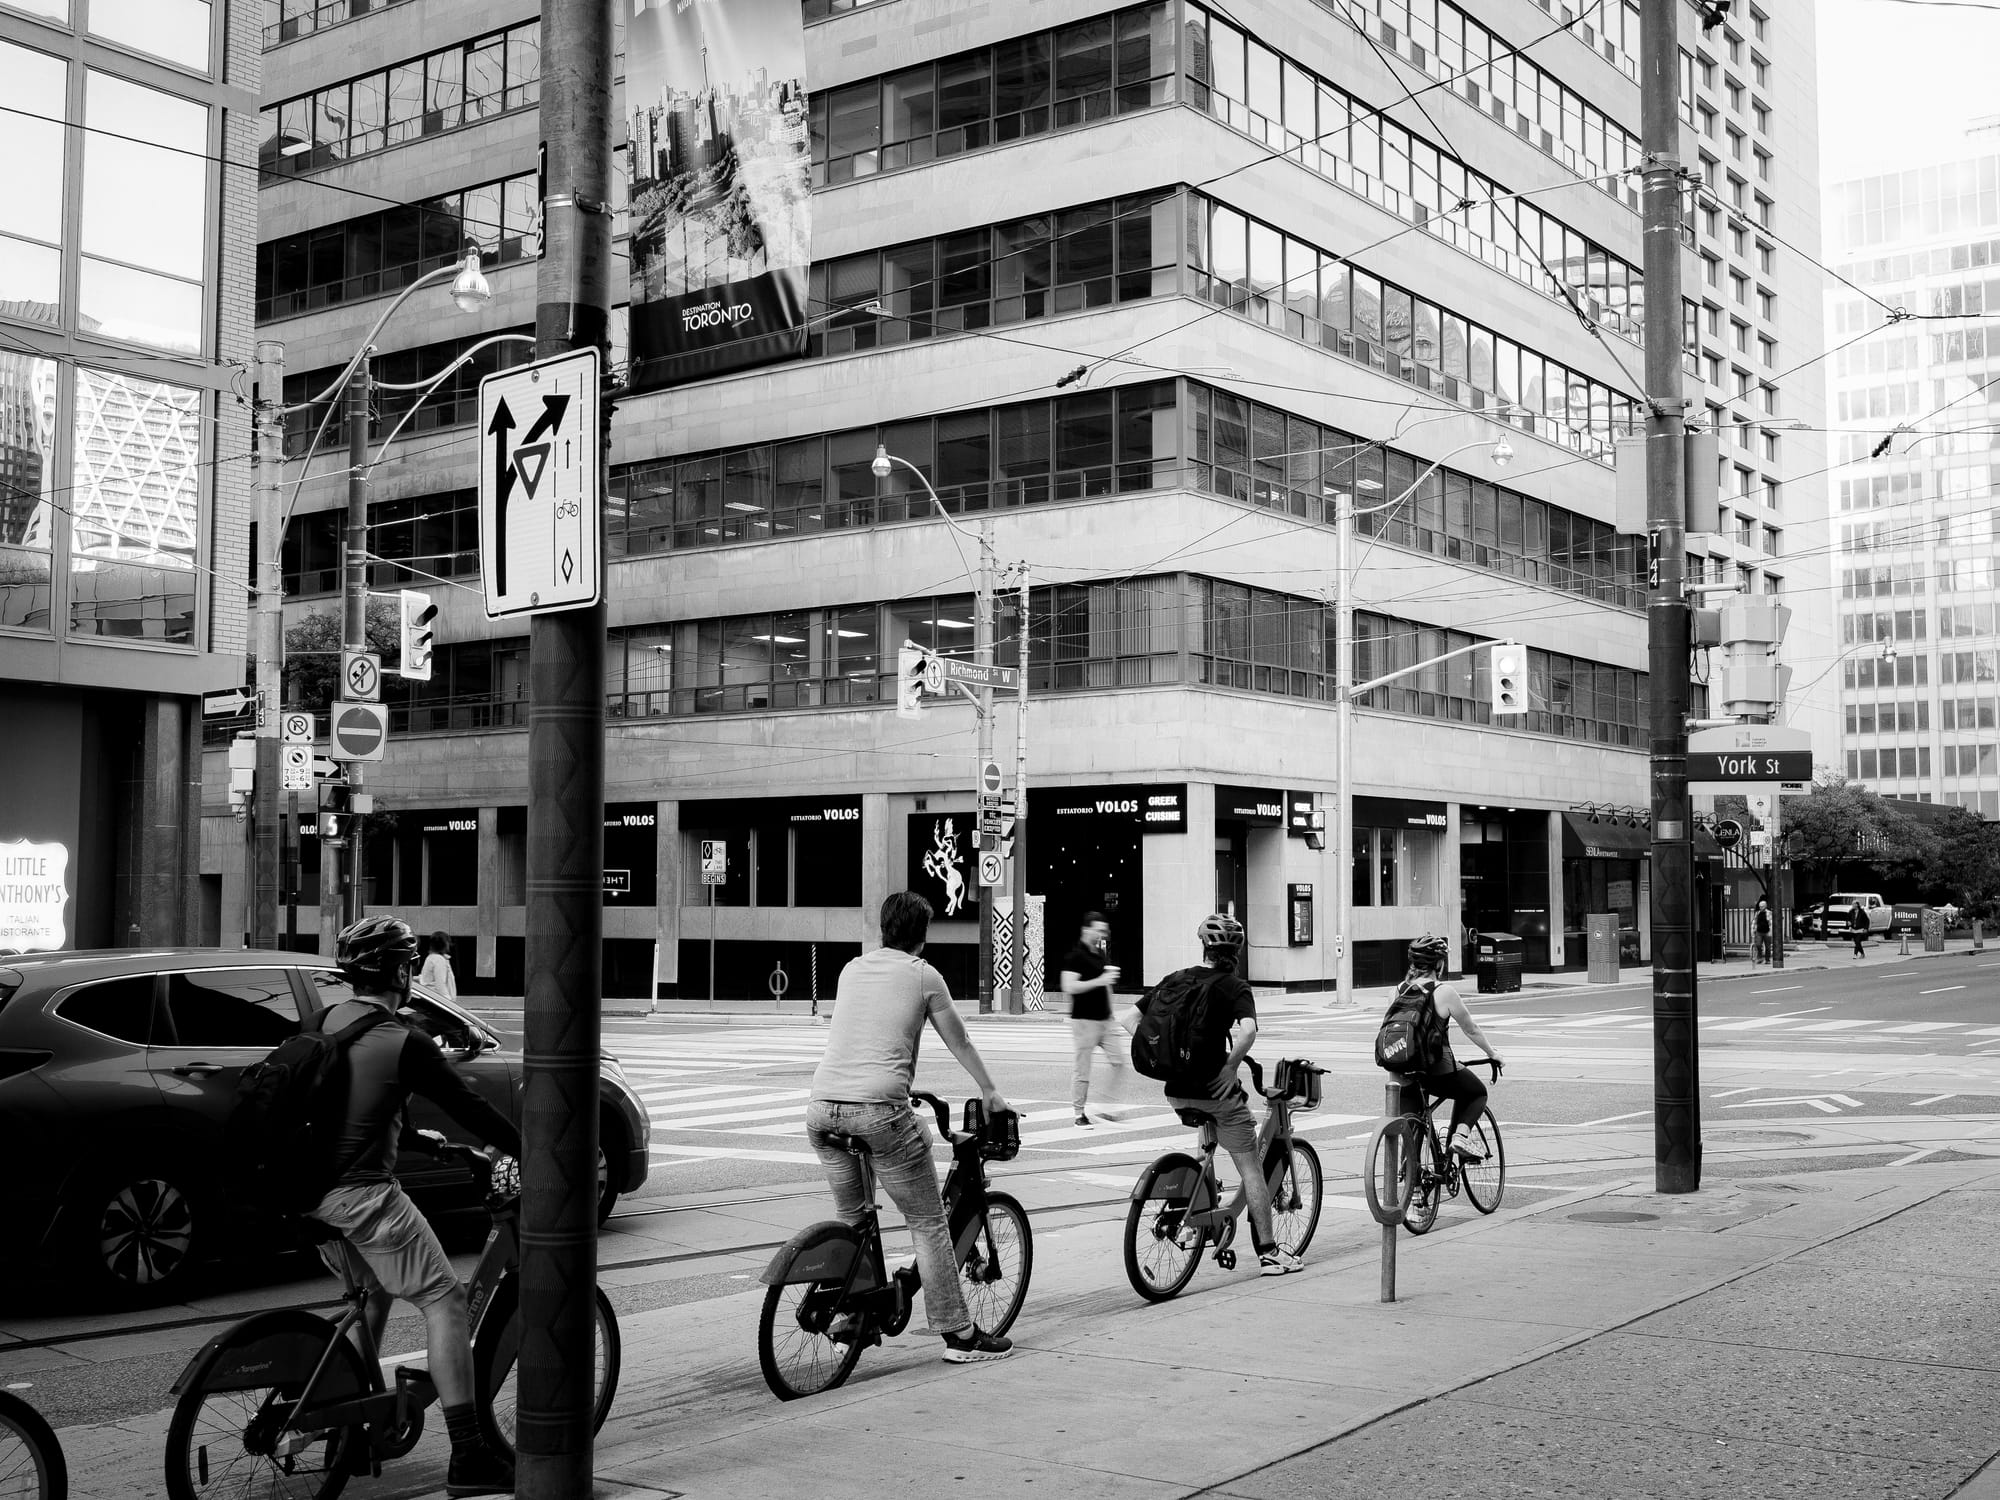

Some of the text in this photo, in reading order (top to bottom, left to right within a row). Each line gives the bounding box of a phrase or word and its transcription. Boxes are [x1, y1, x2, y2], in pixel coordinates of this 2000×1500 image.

[682, 301, 721, 317] DESTINATION
[682, 303, 752, 332] TORONTO
[1650, 532, 1659, 586] T 44
[950, 662, 989, 681] Richmond
[1002, 670, 1011, 683] W
[1718, 755, 1780, 775] York St
[1056, 800, 1138, 815] ESTIATORIO VOLOS
[1148, 796, 1178, 806] GREEK
[824, 808, 860, 820] VOLOS
[1145, 811, 1180, 821] CUISINE
[1257, 803, 1281, 816] VOLOS
[327, 815, 338, 836] 5
[449, 820, 477, 831] VOLOS
[623, 815, 655, 826] VOLOS
[1426, 814, 1446, 826] VOLOS
[6, 857, 47, 876] LITTLE
[703, 874, 726, 883] BEGINS
[1894, 911, 1918, 919] Hilton
[1383, 1037, 1407, 1059] ROOTS
